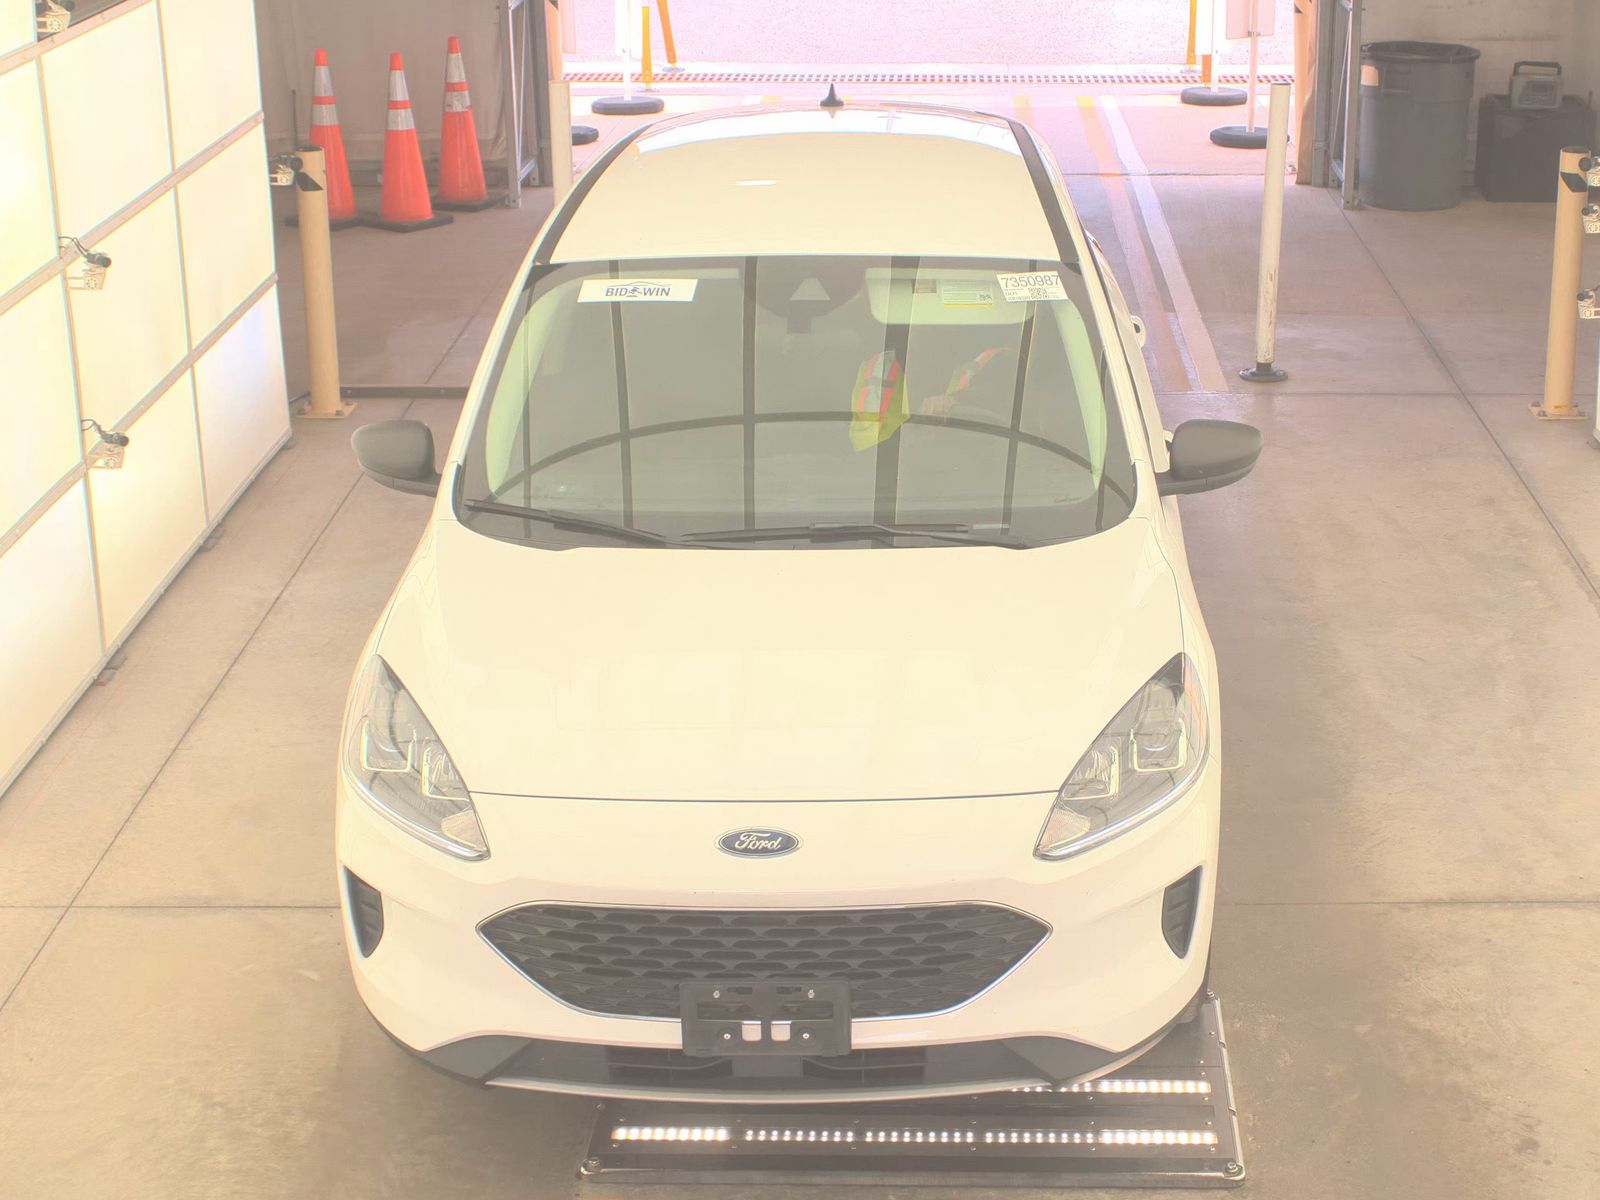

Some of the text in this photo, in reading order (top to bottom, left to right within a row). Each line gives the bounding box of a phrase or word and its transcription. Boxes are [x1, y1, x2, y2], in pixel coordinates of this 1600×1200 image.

[1000, 274, 1060, 289] 7350987
[605, 287, 671, 297] BID WIN
[734, 832, 782, 850] Ford
